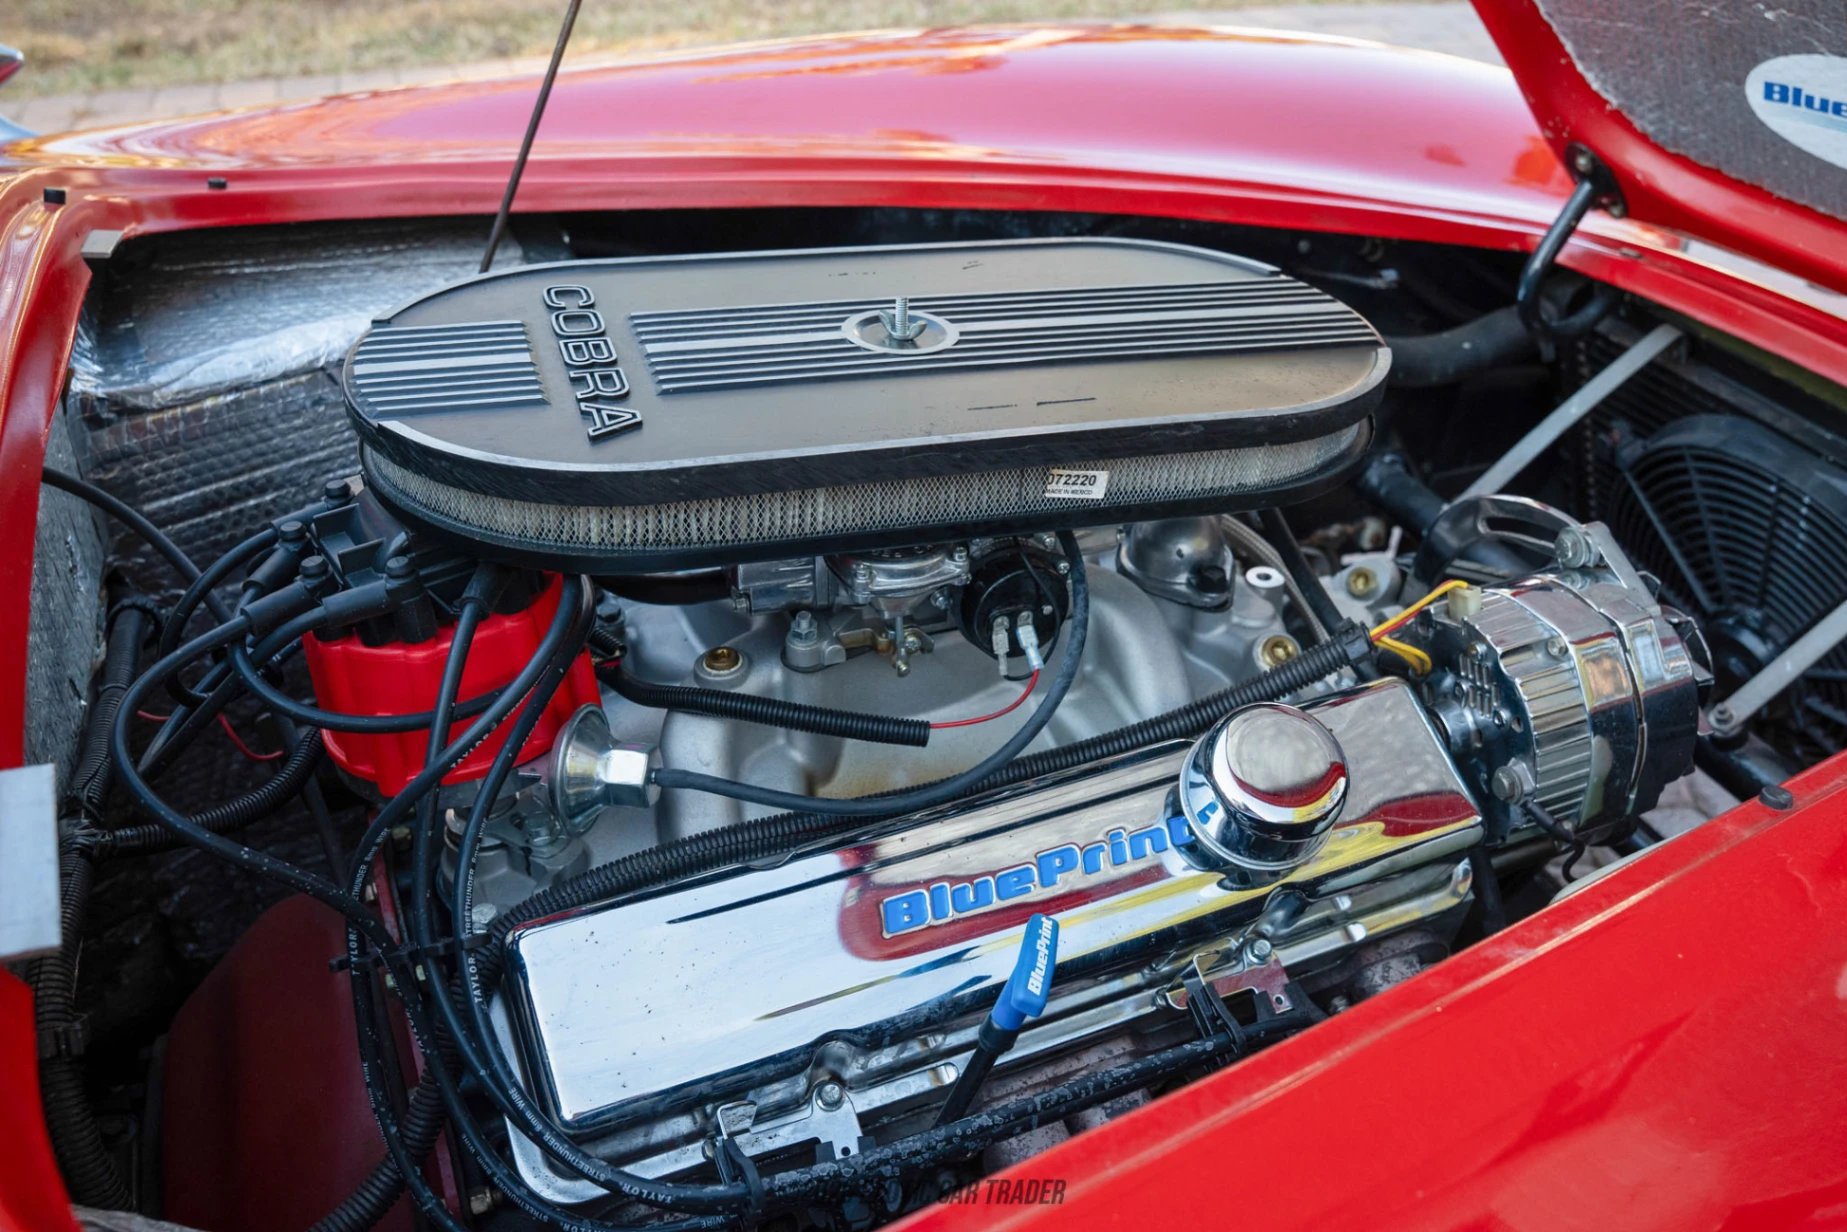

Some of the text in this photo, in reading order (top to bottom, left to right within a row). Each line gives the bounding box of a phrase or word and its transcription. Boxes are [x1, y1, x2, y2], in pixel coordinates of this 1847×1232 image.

[542, 284, 643, 443] COBRA
[883, 816, 1196, 935] BluePrint
[348, 932, 360, 976] TYLOR
[468, 956, 483, 1003] TAYLOR
[1027, 916, 1053, 996] BluePrint
[508, 1086, 673, 1205] TAYLOR STREETHUNDER 8mm WIRE
